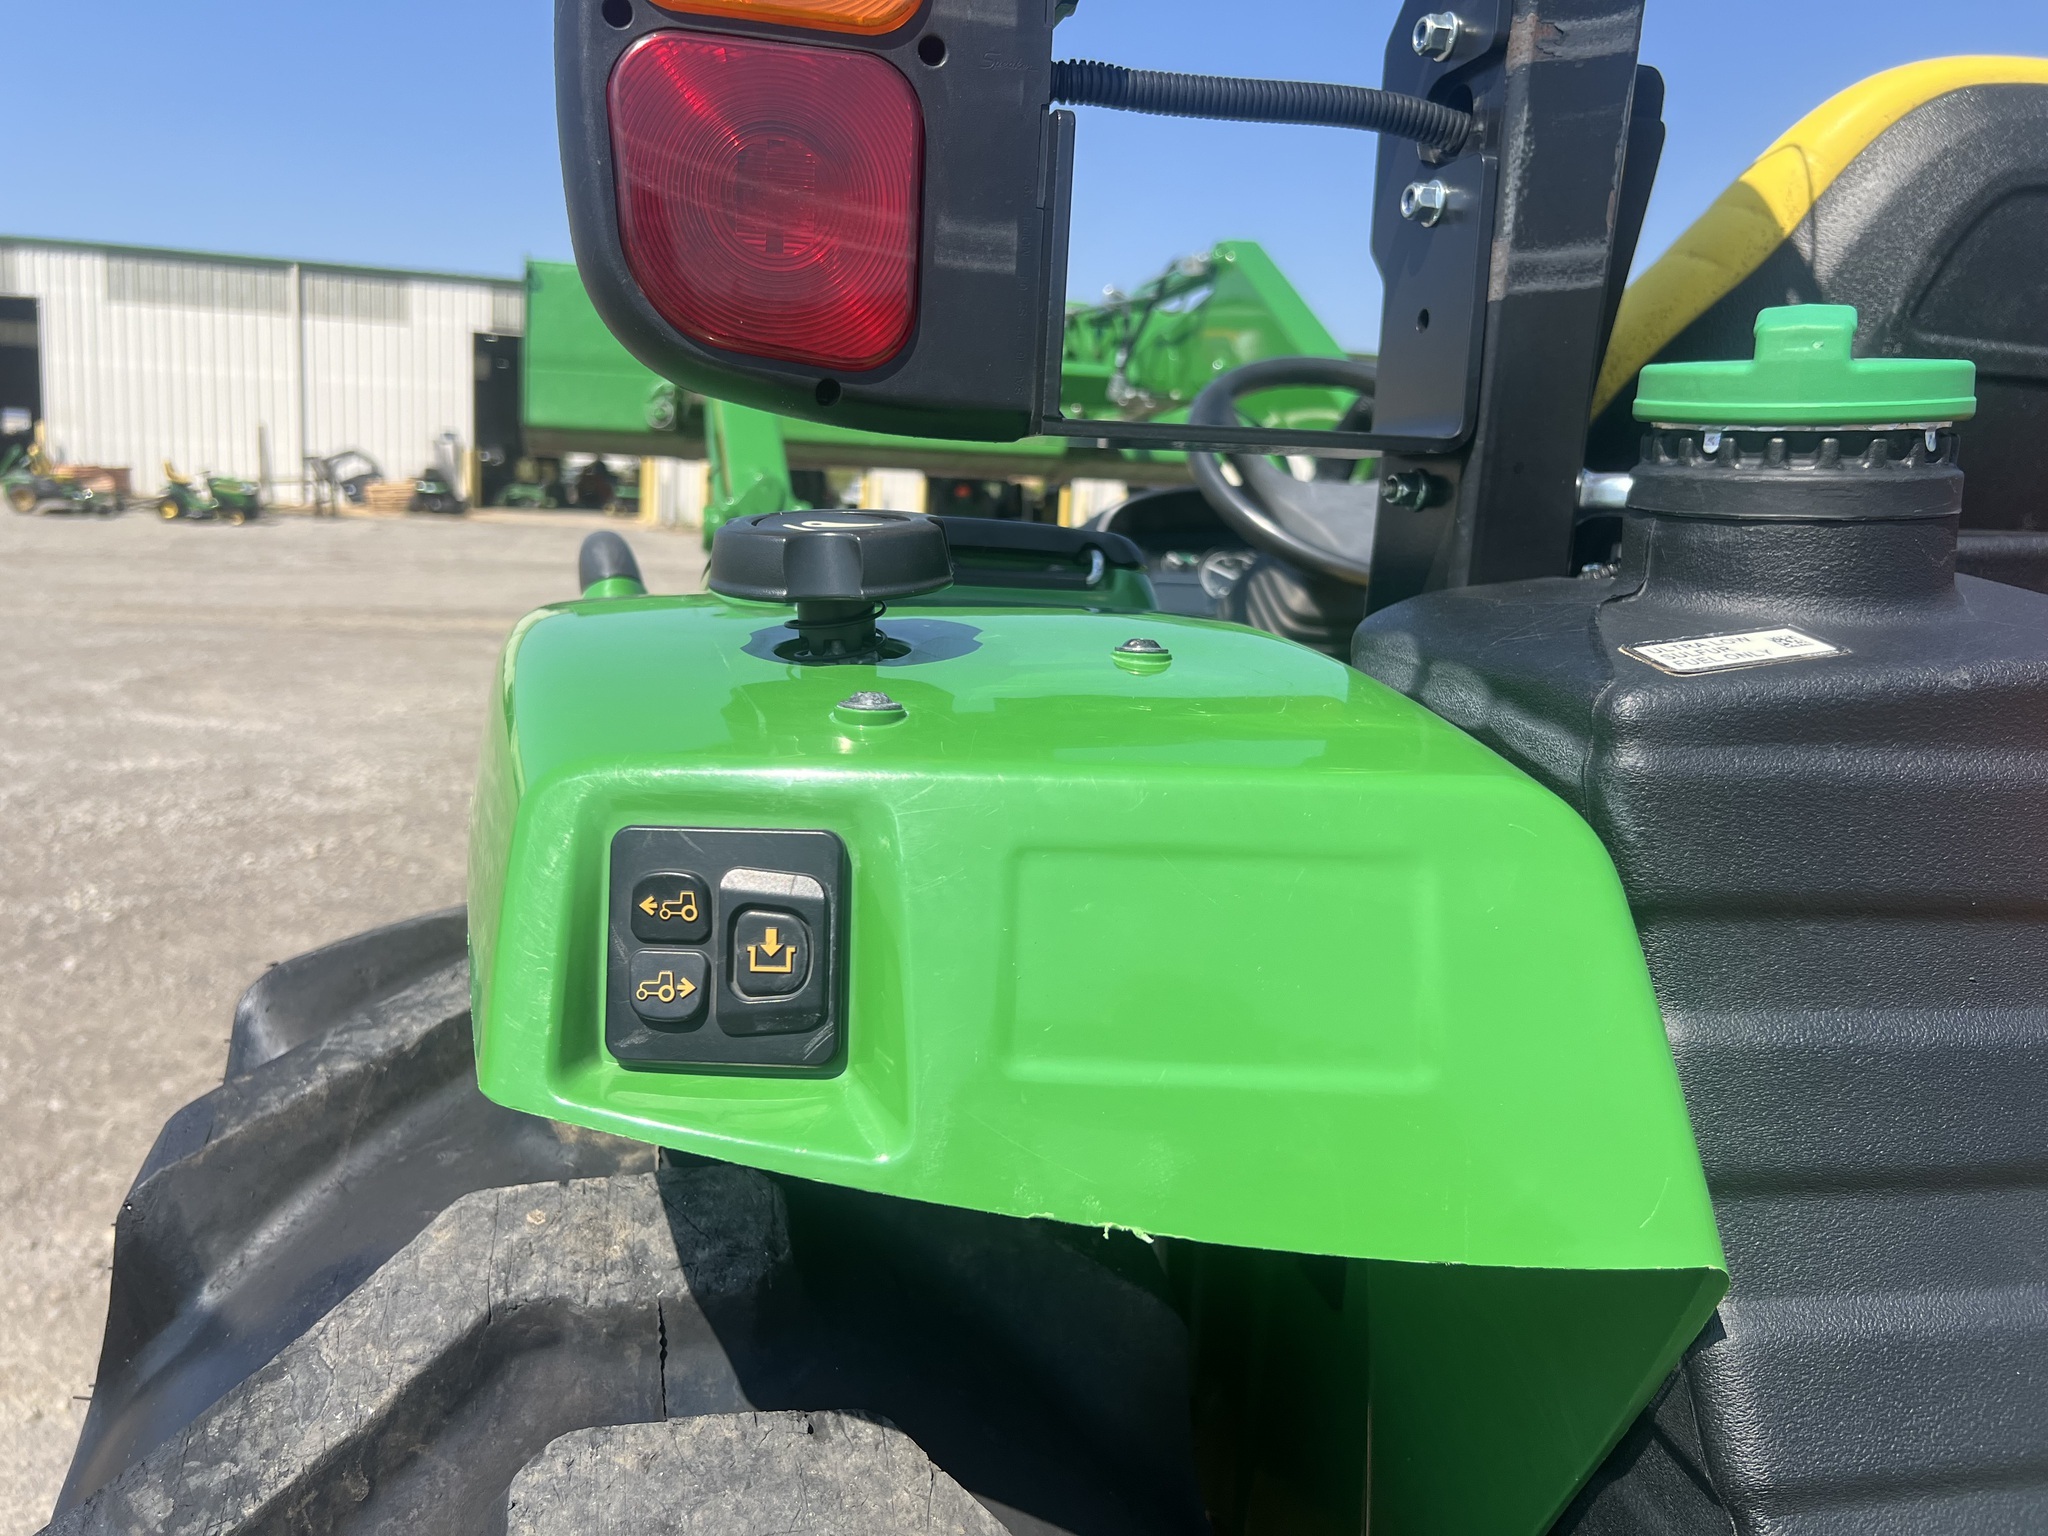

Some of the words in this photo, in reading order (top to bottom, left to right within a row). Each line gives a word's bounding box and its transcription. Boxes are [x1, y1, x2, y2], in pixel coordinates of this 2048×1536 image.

[1646, 642, 1709, 654] ULTRA
[1713, 636, 1751, 646] LOW
[1660, 646, 1732, 660] SULFUR
[1673, 655, 1725, 667] FUEL
[1723, 649, 1773, 660] ONLY
